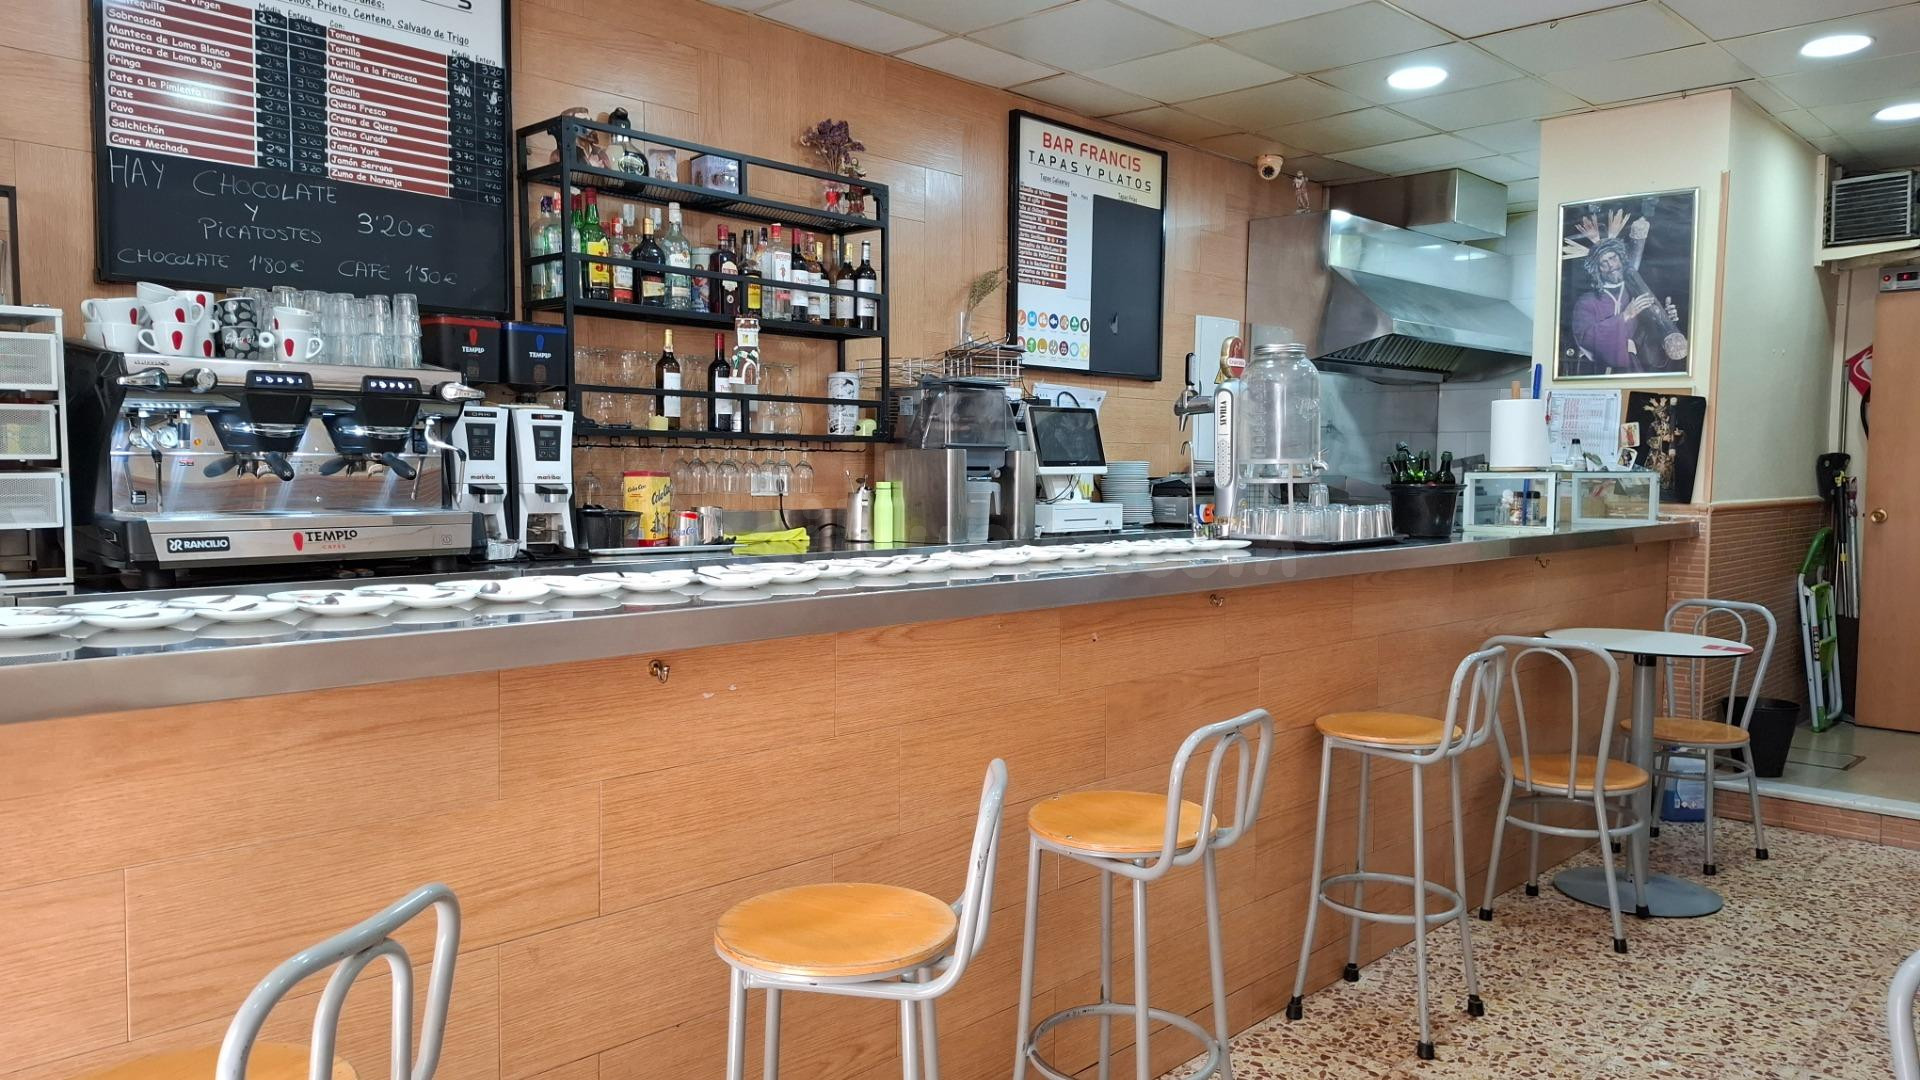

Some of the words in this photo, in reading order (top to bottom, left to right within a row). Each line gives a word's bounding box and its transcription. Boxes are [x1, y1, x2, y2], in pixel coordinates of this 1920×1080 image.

[108, 8, 162, 28] Sobrasada
[354, 8, 395, 28] Centeno,
[397, 20, 431, 36] Salvado
[434, 28, 444, 39] de
[447, 31, 469, 46] Trigo
[109, 24, 153, 41] Manteca
[156, 36, 168, 45] de
[172, 37, 197, 51] Lomo
[200, 43, 230, 58] Blanco
[329, 29, 361, 44] Tomate
[109, 38, 153, 55] Manteca
[156, 50, 169, 58] de
[172, 51, 197, 64] Lomo
[200, 57, 222, 70] Rojo
[329, 43, 361, 58] Tortilla
[109, 53, 142, 69] Pringa
[109, 70, 134, 84] Pate
[137, 78, 144, 86] a
[147, 77, 157, 88] la
[329, 57, 361, 72] Tortilla
[372, 66, 380, 75] la
[382, 68, 418, 84] Francesa
[329, 71, 355, 84] Melva
[110, 86, 134, 99] Pate
[329, 85, 361, 99] Caballa
[110, 101, 134, 114] Pavo
[330, 99, 357, 111] Queso
[359, 104, 387, 117] Fresco
[111, 118, 165, 136] Salchichón
[330, 113, 357, 125] Crema
[360, 119, 370, 127] de
[372, 121, 398, 133] Queso
[111, 134, 141, 147] Carne
[145, 139, 189, 154] Mechada
[330, 127, 357, 138] Queso
[359, 133, 388, 145] Curado
[331, 141, 358, 153] Jamón
[360, 146, 380, 157] York
[1043, 131, 1074, 155] BAR
[1079, 142, 1142, 173] FRANCIS
[331, 155, 358, 167] Jamón
[360, 161, 394, 173] Serrano
[1028, 149, 1079, 173] TAPAS
[1085, 164, 1093, 177] Y
[1098, 168, 1152, 192] PLATOS
[108, 148, 166, 191] HAY
[192, 169, 338, 205] CHOCOLATE
[331, 168, 354, 179] Zumo
[356, 173, 366, 181] de
[369, 174, 403, 188] Naranja
[244, 202, 259, 222] Y
[116, 247, 231, 269] CHOCOLATE
[337, 259, 391, 282] CAFE
[184, 538, 229, 550] RANCILIO
[305, 529, 358, 542] TEMPLO
